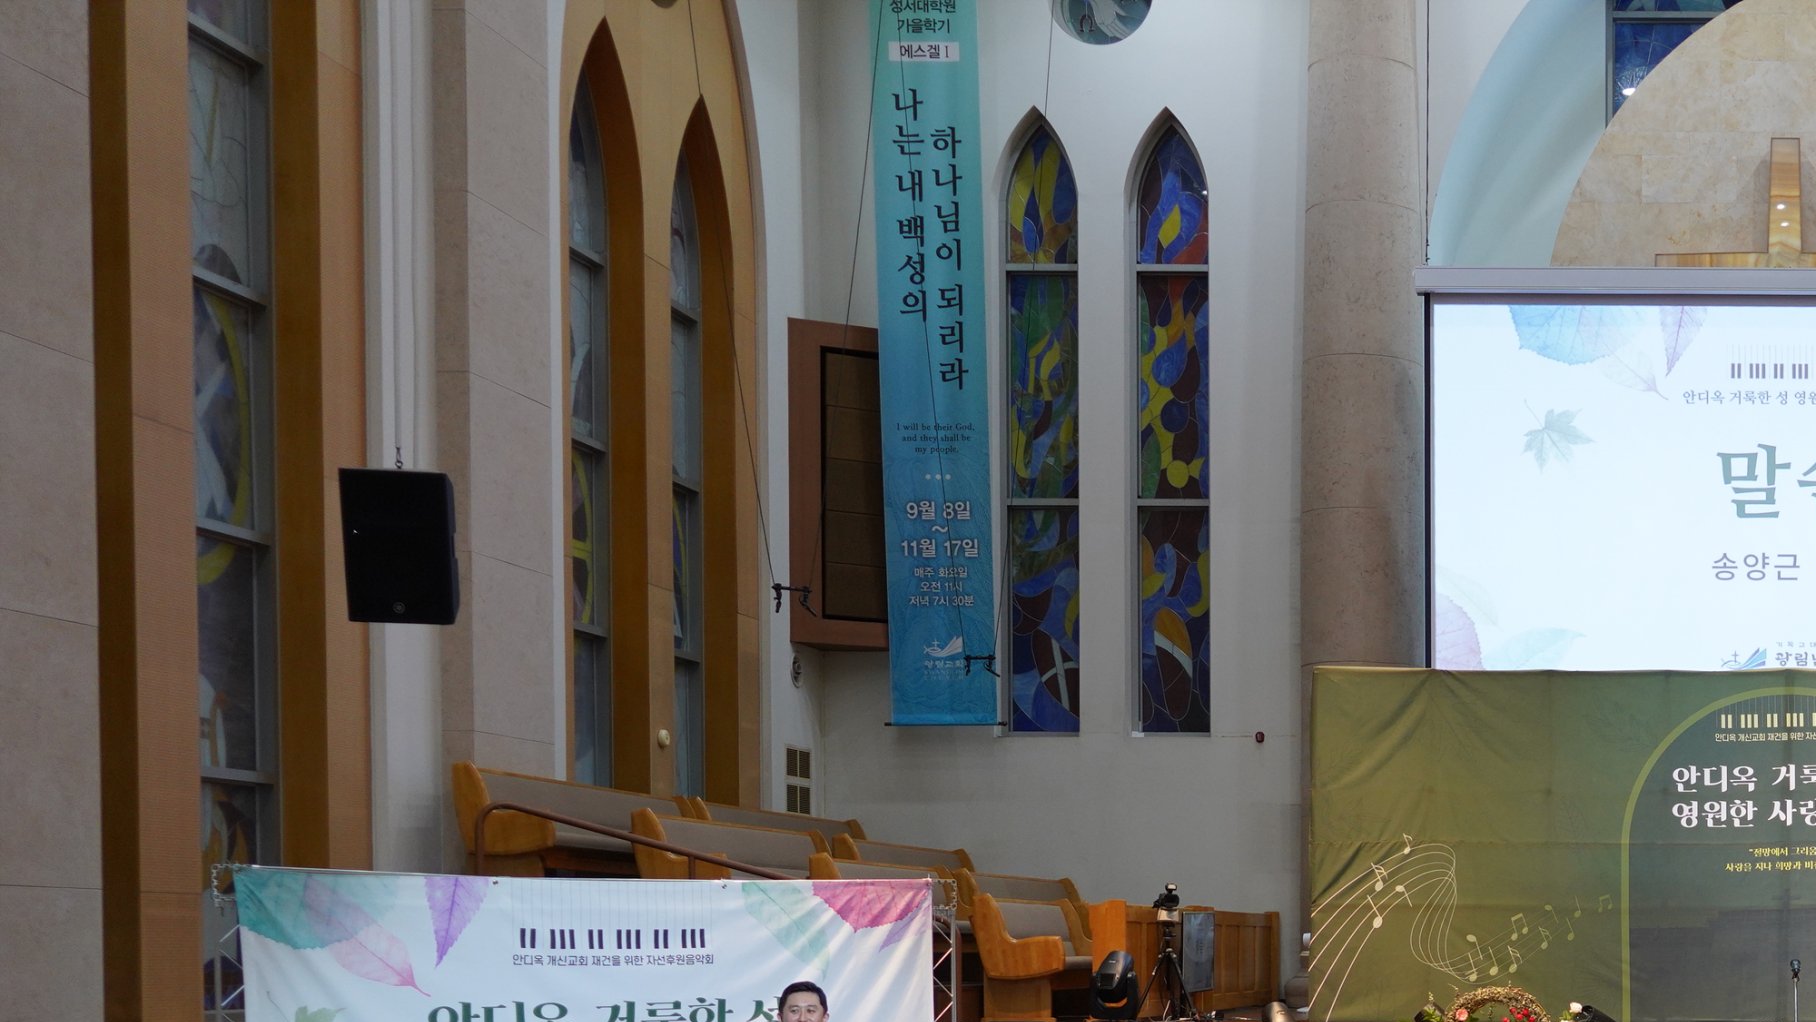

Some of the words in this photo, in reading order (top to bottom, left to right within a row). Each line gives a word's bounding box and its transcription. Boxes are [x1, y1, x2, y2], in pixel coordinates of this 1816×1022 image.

[889, 0, 957, 13] 성서대학원
[897, 18, 950, 34] 가을학기
[900, 44, 940, 59] 에스겔
[891, 88, 925, 156] 나는
[895, 170, 923, 202] 내
[929, 125, 963, 271] 하나님이
[896, 214, 927, 322] 백성의
[937, 283, 969, 391] 되리라
[1682, 390, 1725, 405] 안디옥
[1729, 390, 1772, 405] 거룩한
[1776, 391, 1789, 406] 성
[903, 422, 919, 431] will
[921, 423, 931, 431] be
[933, 423, 953, 431] their
[902, 434, 917, 442] and
[920, 434, 937, 443] they
[940, 433, 959, 442] shall
[961, 433, 971, 442] be
[915, 446, 926, 454] my
[906, 501, 936, 520] 9월
[943, 501, 971, 520] 8일
[901, 539, 936, 557] 11월
[943, 539, 979, 557] 17일
[914, 567, 934, 578] 매주
[938, 567, 968, 578] 화요일
[1711, 552, 1801, 582] 송양근
[921, 581, 941, 592] 오전
[945, 581, 963, 592] 11시
[909, 595, 929, 606] 저녁
[933, 595, 949, 606] 7시
[952, 595, 975, 606] 30분
[1715, 733, 1737, 742] 안디옥
[1737, 733, 1766, 742] 개신교회
[1767, 732, 1789, 741] 재건을
[1789, 732, 1804, 741] 위한
[1671, 764, 1758, 793] 안디옥
[1671, 799, 1758, 828] 영원한
[1725, 862, 1752, 872] 사랑을
[1755, 861, 1772, 872] 지나
[1775, 861, 1802, 871] 희망과
[512, 954, 544, 966] 안디옥
[547, 955, 588, 967] 개신교회
[591, 955, 621, 966] 재건을
[624, 955, 644, 966] 위한
[646, 953, 714, 966] 자선후원음악회
